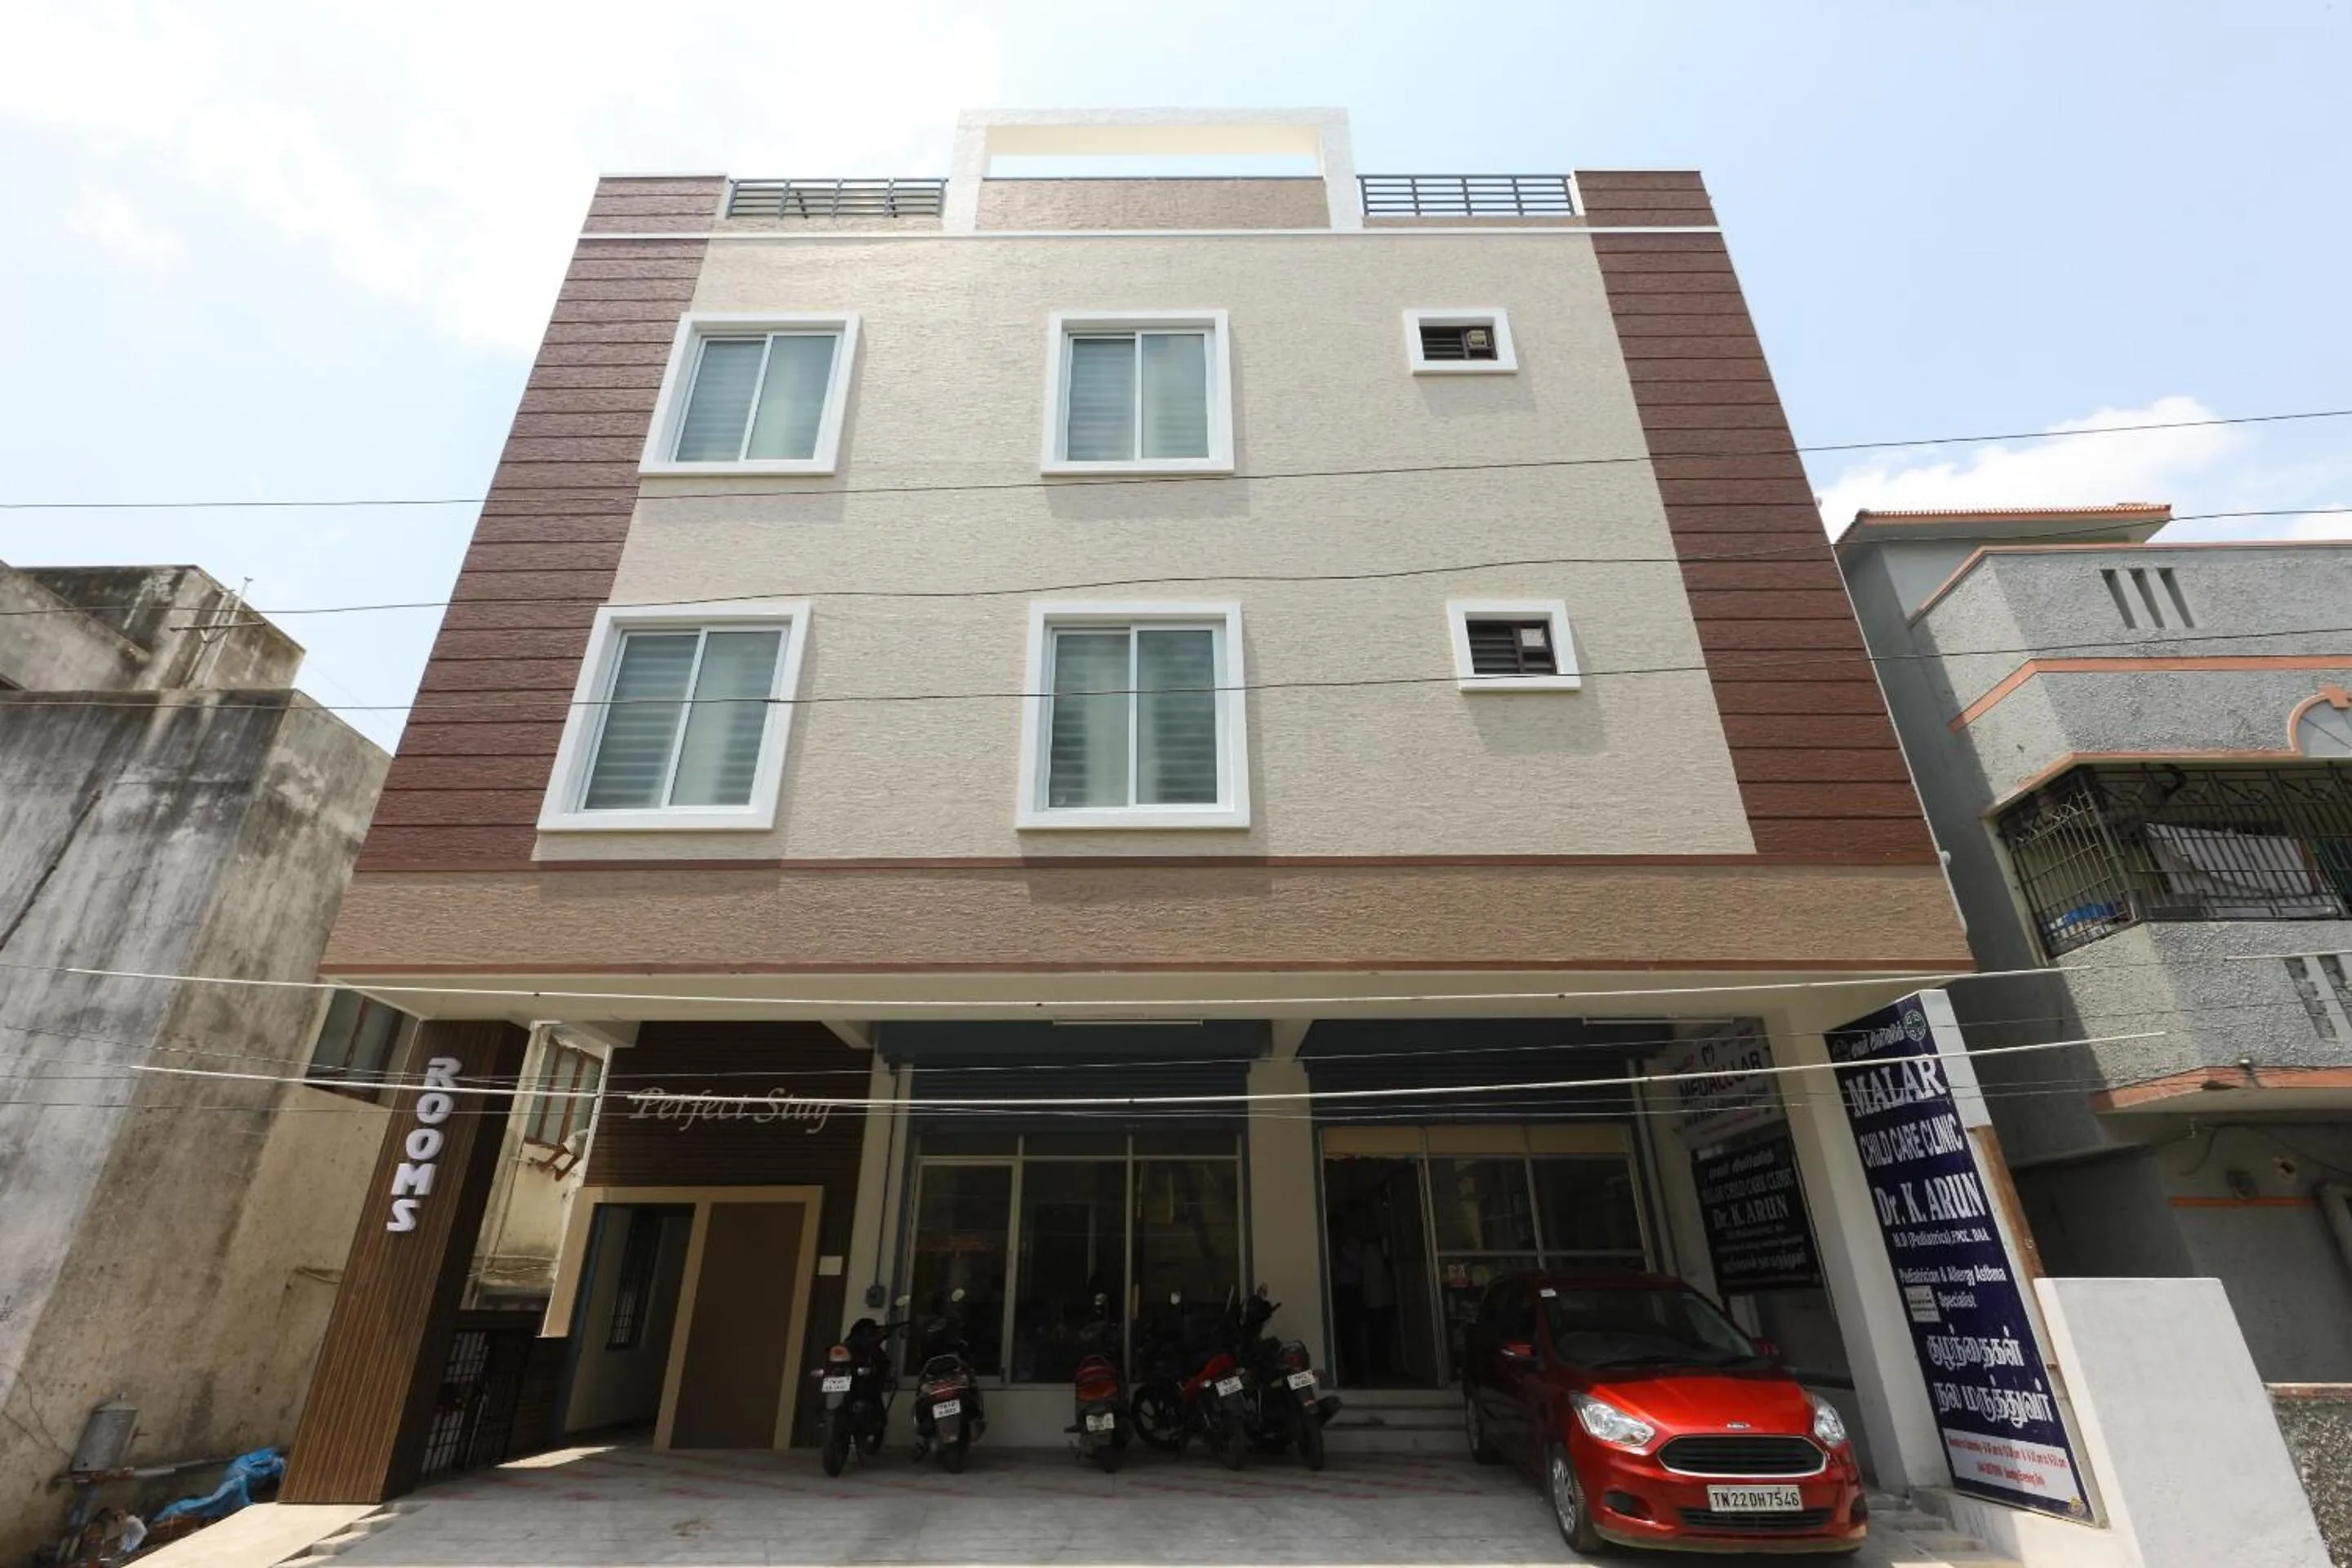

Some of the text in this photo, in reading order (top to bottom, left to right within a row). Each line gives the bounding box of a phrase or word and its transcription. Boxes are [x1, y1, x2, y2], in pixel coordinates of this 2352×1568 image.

[628, 1087, 833, 1134] Perfect Stay
[1845, 1057, 1946, 1117] MALAR
[386, 1057, 462, 1232] ROOMS
[1859, 1113, 1964, 1169] CHILD CARE CLINIC
[1746, 1195, 1790, 1224] ARUN
[1874, 1172, 1986, 1226] Dr. K. ARUN
